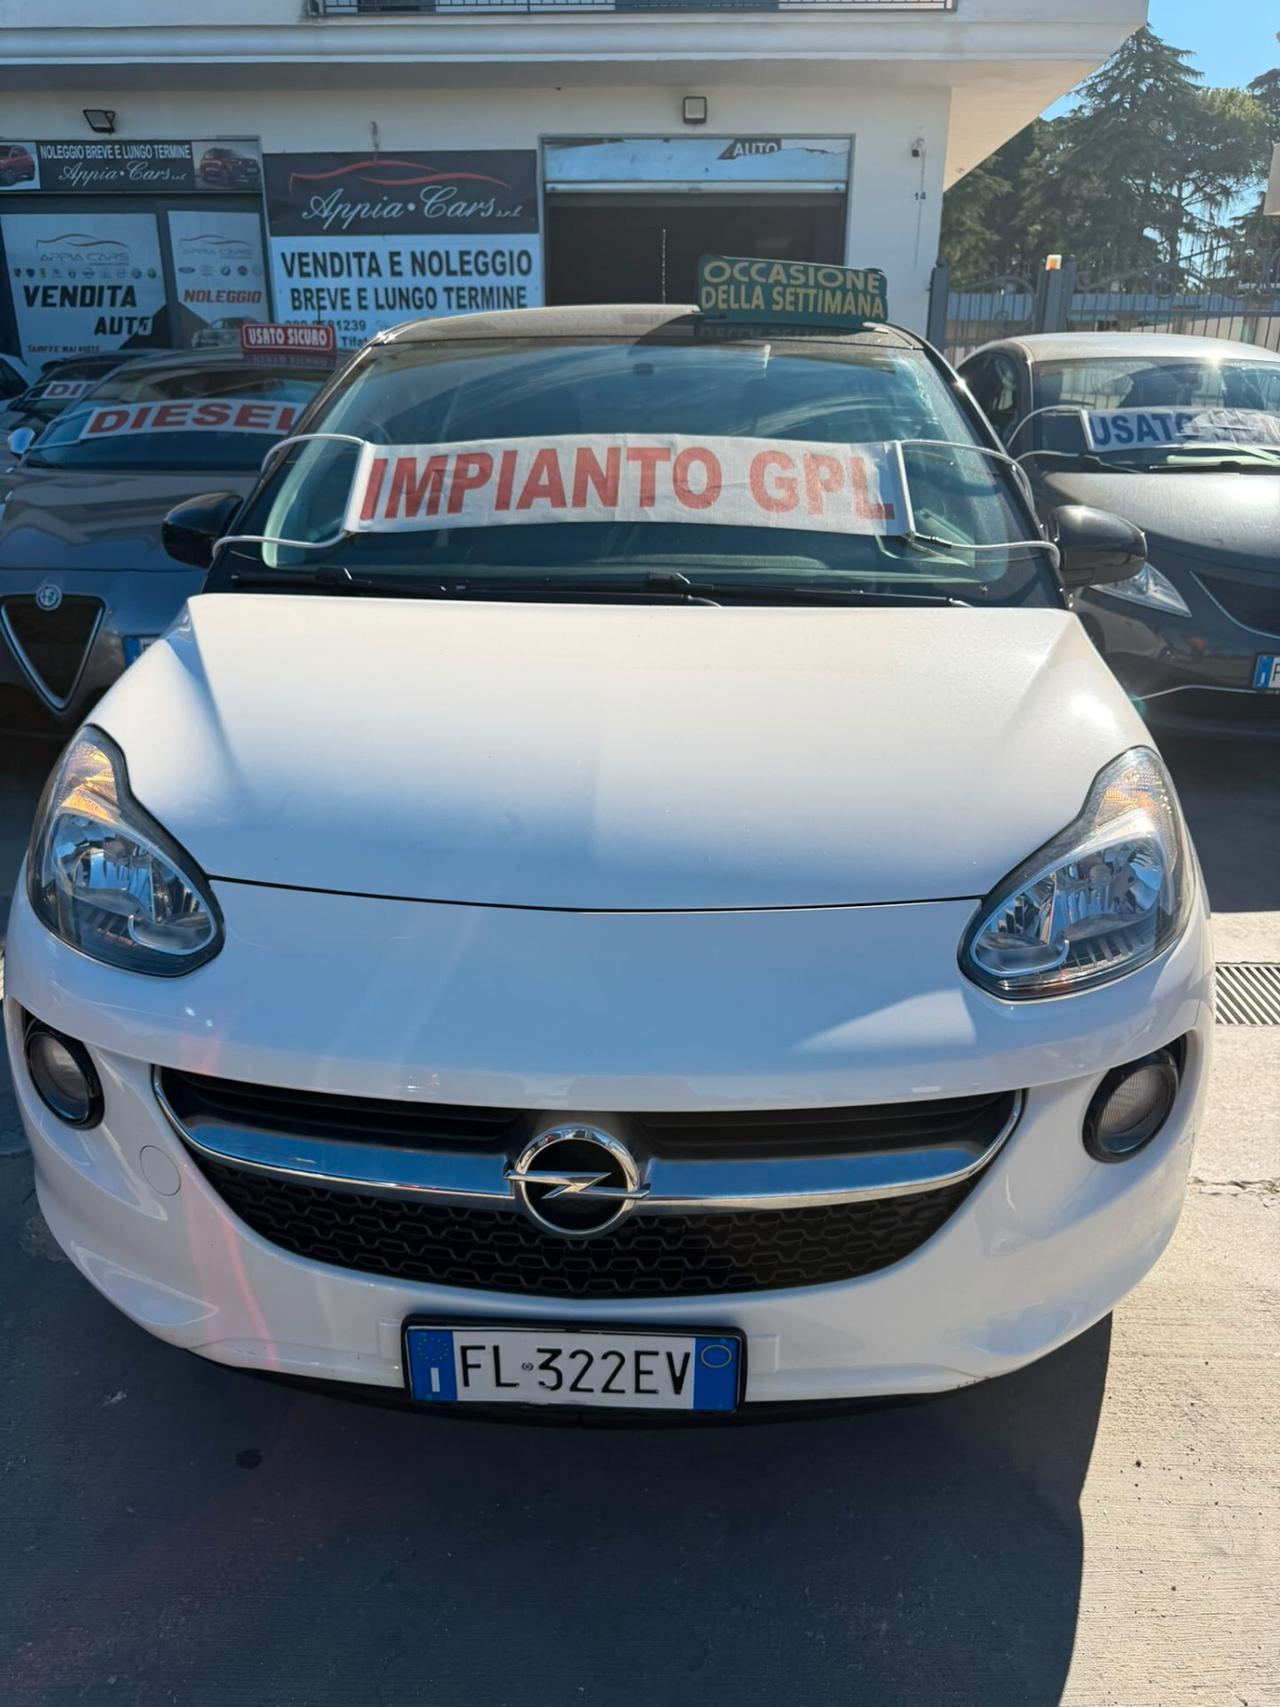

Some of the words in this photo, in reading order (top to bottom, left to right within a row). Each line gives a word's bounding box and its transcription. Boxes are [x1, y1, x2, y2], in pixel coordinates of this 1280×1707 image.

[40, 145, 84, 159] NOLEGGIO
[86, 145, 113, 159] BREVE
[115, 145, 122, 158] E
[123, 145, 152, 159] LUNGO
[153, 144, 191, 159] TERMINE
[58, 161, 119, 187] Appia
[127, 160, 170, 181] Cars
[302, 188, 404, 230] Appia
[420, 185, 495, 218] Cars
[280, 250, 382, 278] VENDITA
[389, 250, 403, 277] E
[411, 249, 533, 277] NOLEGGIO
[703, 260, 881, 294] OCCASIONE
[23, 285, 137, 308] VENDITA
[183, 288, 262, 304] NOLEGGIO
[290, 287, 351, 311] BREVE
[357, 287, 369, 311] E
[374, 287, 437, 311] LUNGO
[443, 286, 528, 310] TERMINE
[701, 285, 765, 310] DELLA
[772, 287, 884, 319] SETTIMANA
[94, 316, 153, 336] AUTO
[248, 328, 285, 345] USATO
[287, 328, 327, 347] SICURO
[359, 446, 723, 521] IMPIANTO
[748, 449, 896, 520] GPL
[460, 1345, 520, 1388] FL
[536, 1347, 691, 1395] 322EV
